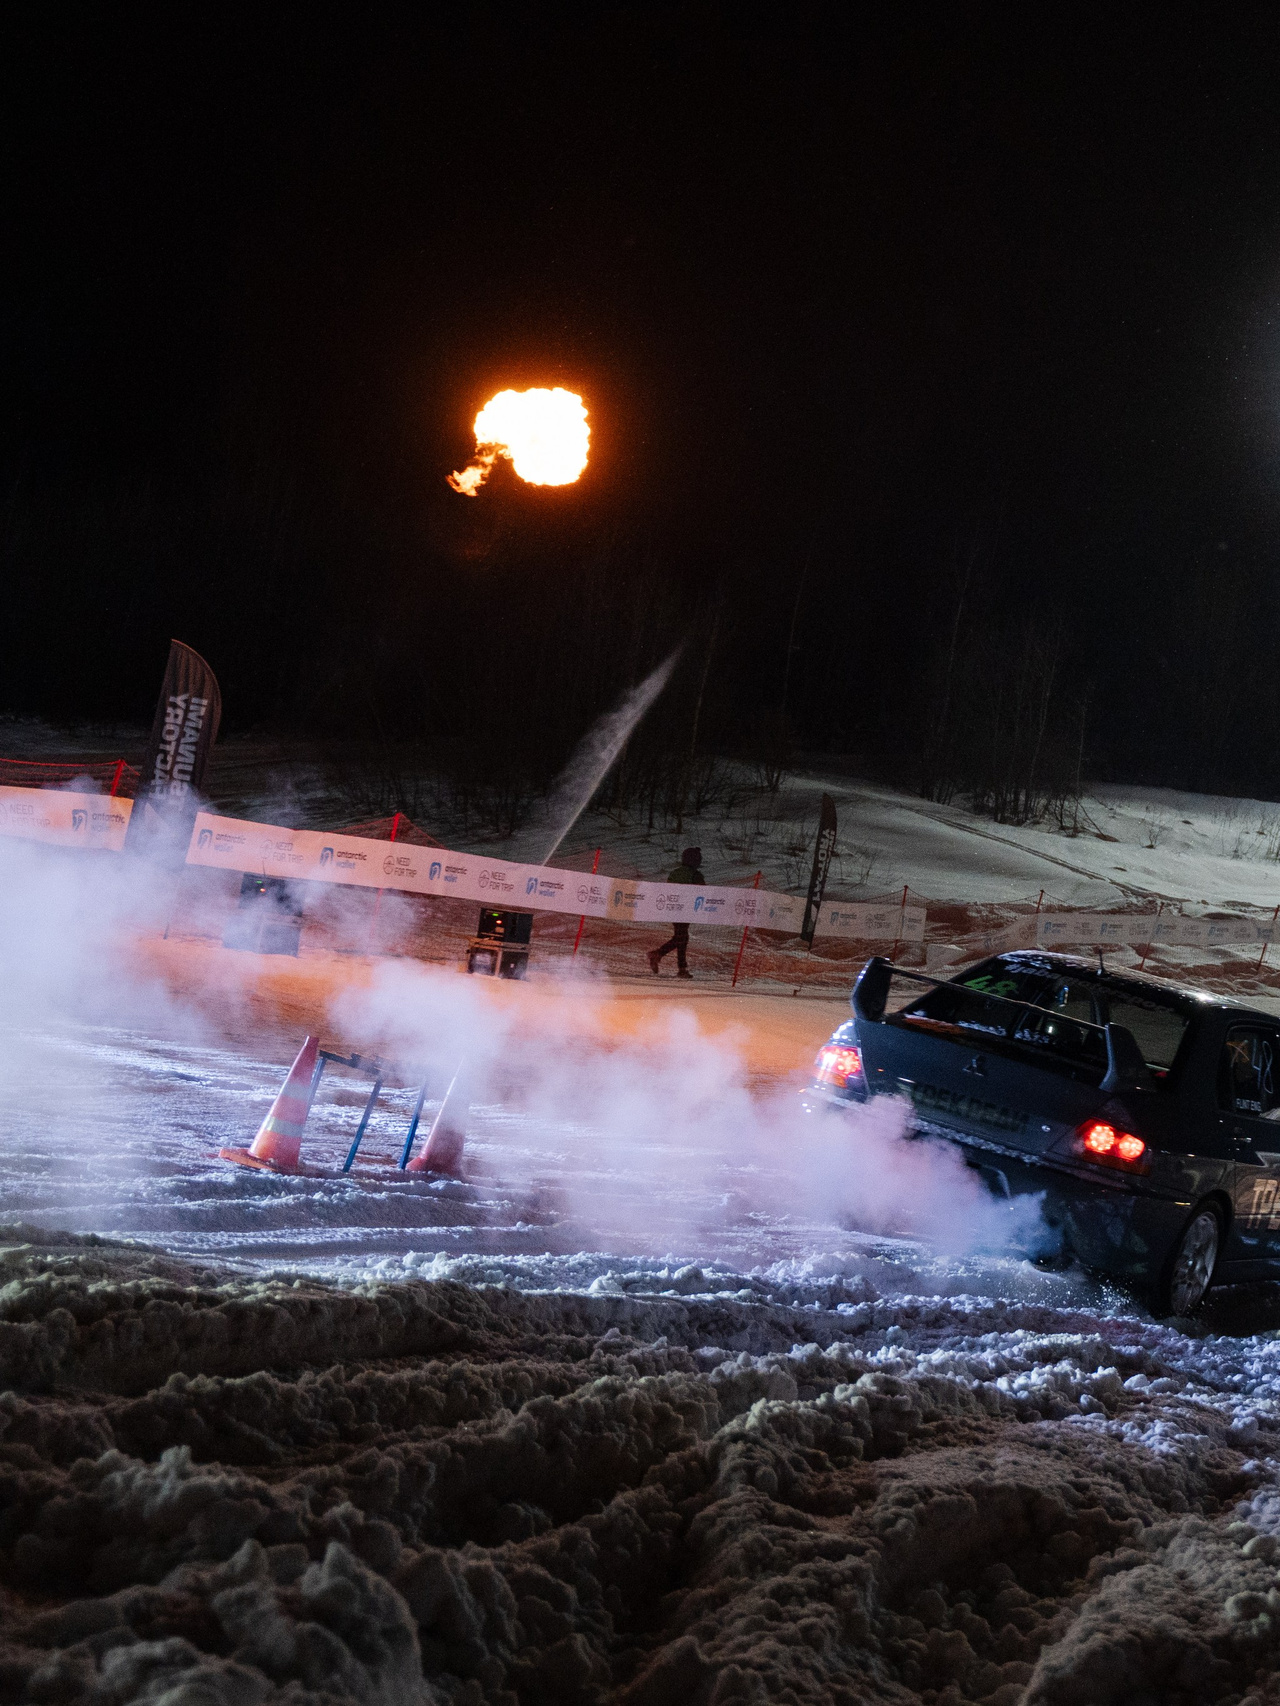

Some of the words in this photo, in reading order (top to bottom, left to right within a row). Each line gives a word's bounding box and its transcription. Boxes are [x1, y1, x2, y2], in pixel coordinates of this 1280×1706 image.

[336, 850, 368, 862] antarctic
[396, 856, 412, 867] NEED
[394, 867, 406, 876] FOR
[406, 869, 418, 879] TRIP
[444, 865, 468, 876] antarctic
[490, 871, 507, 882] NEED
[488, 881, 501, 891] FOR
[501, 883, 515, 893] TRIP
[1250, 1039, 1275, 1094] 48
